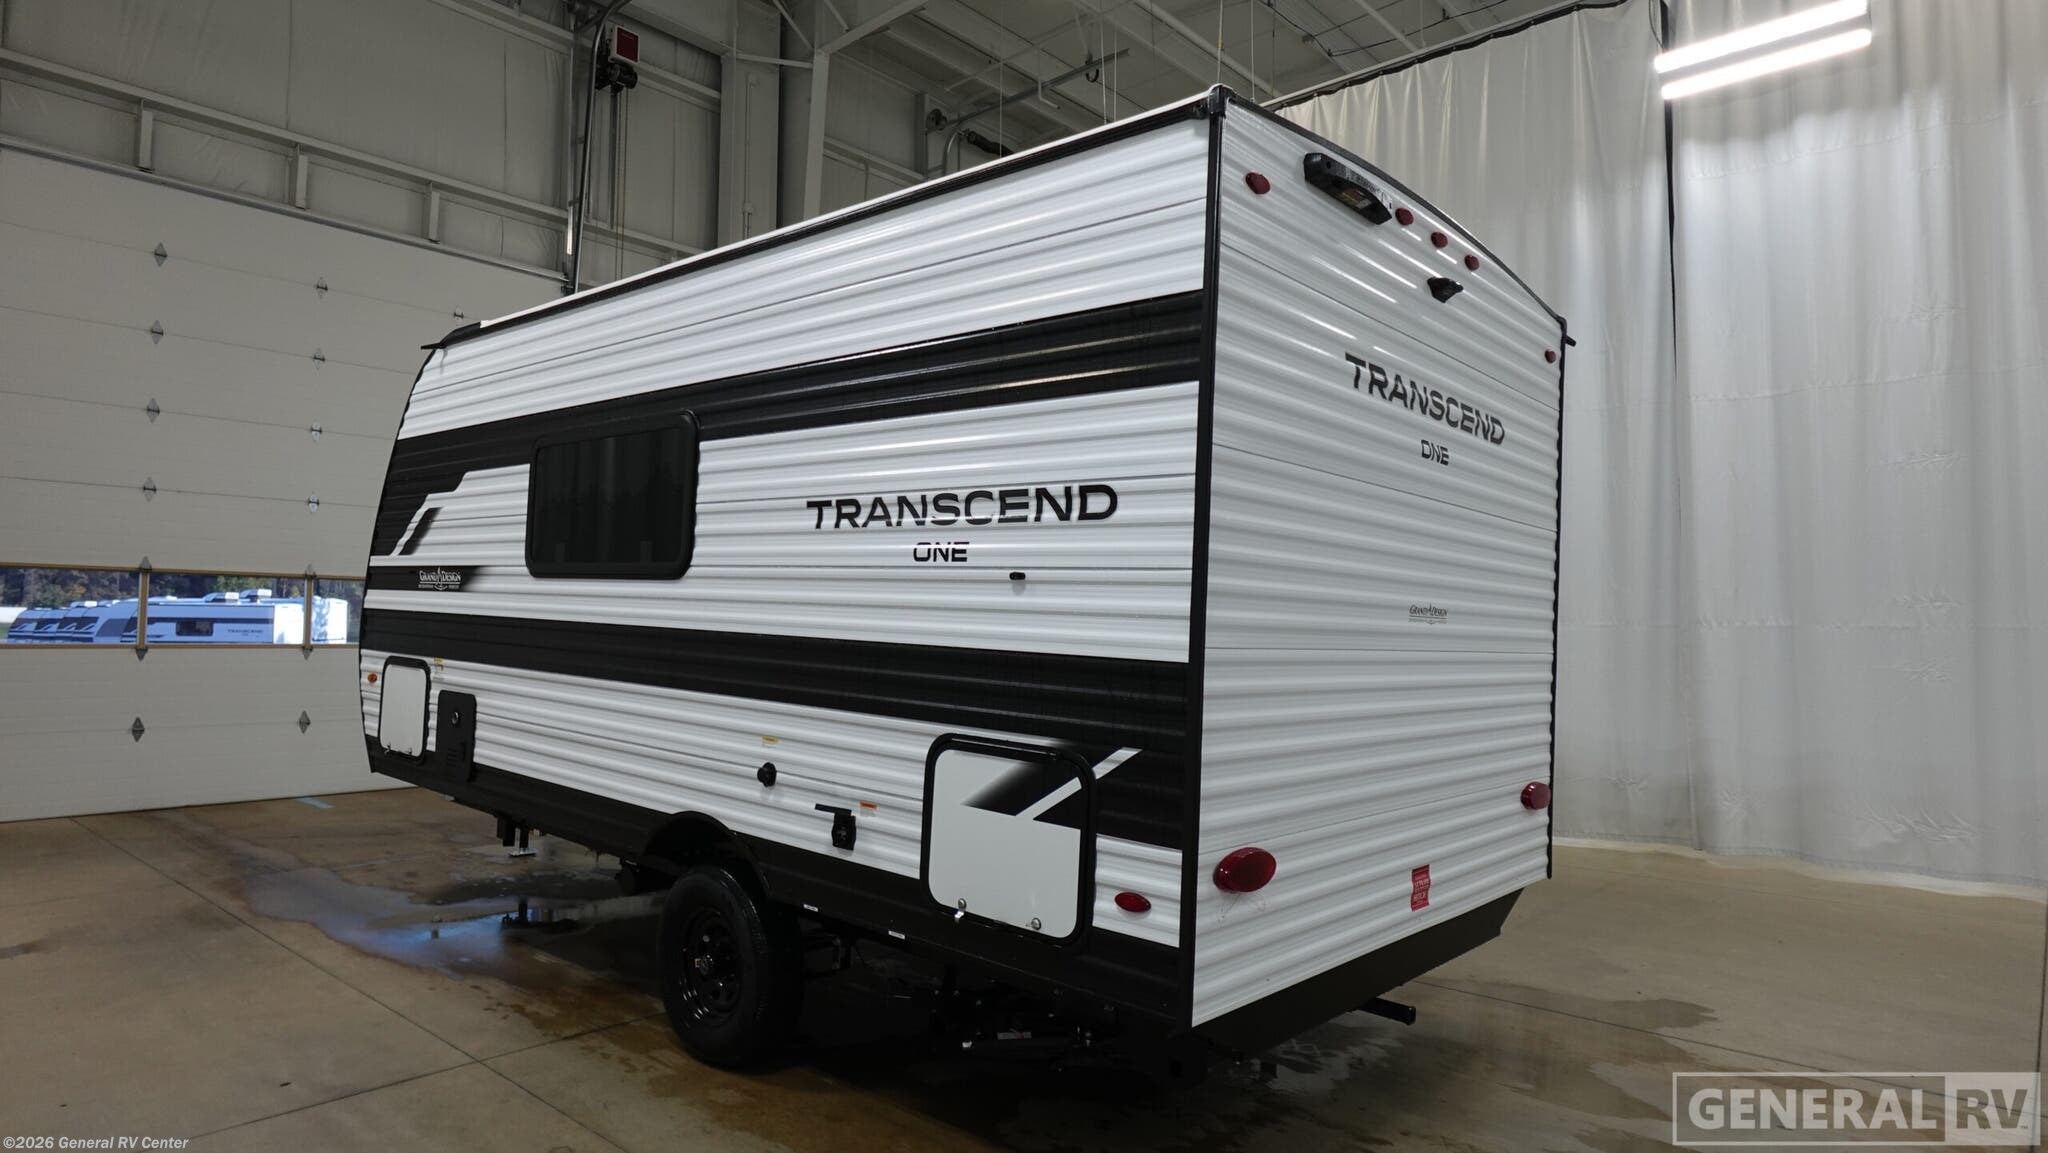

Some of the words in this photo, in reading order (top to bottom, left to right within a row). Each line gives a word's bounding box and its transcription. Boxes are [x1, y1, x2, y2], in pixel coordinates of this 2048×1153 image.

[1345, 352, 1505, 446] TRANSCEND
[806, 484, 1118, 529] TRANSCEND
[913, 541, 970, 562] ONE
